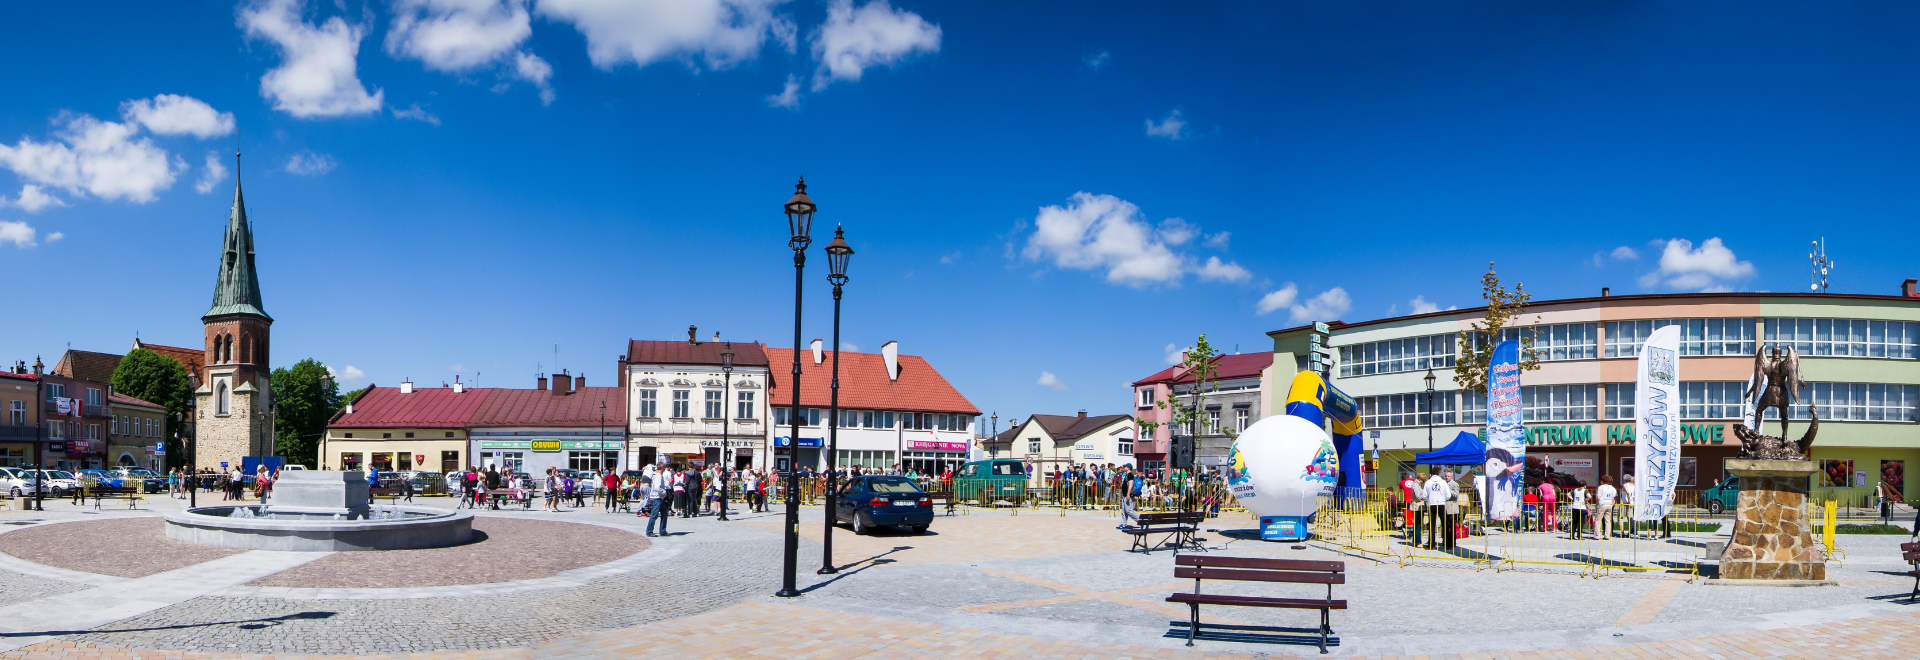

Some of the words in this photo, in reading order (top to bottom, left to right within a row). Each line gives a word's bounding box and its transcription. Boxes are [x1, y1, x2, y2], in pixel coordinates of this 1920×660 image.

[1493, 364, 1519, 373] Centrum
[1524, 425, 1592, 443] NTRUM
[532, 441, 559, 449] OBUWIE
[1643, 386, 1667, 519] STRZYŻÓW
